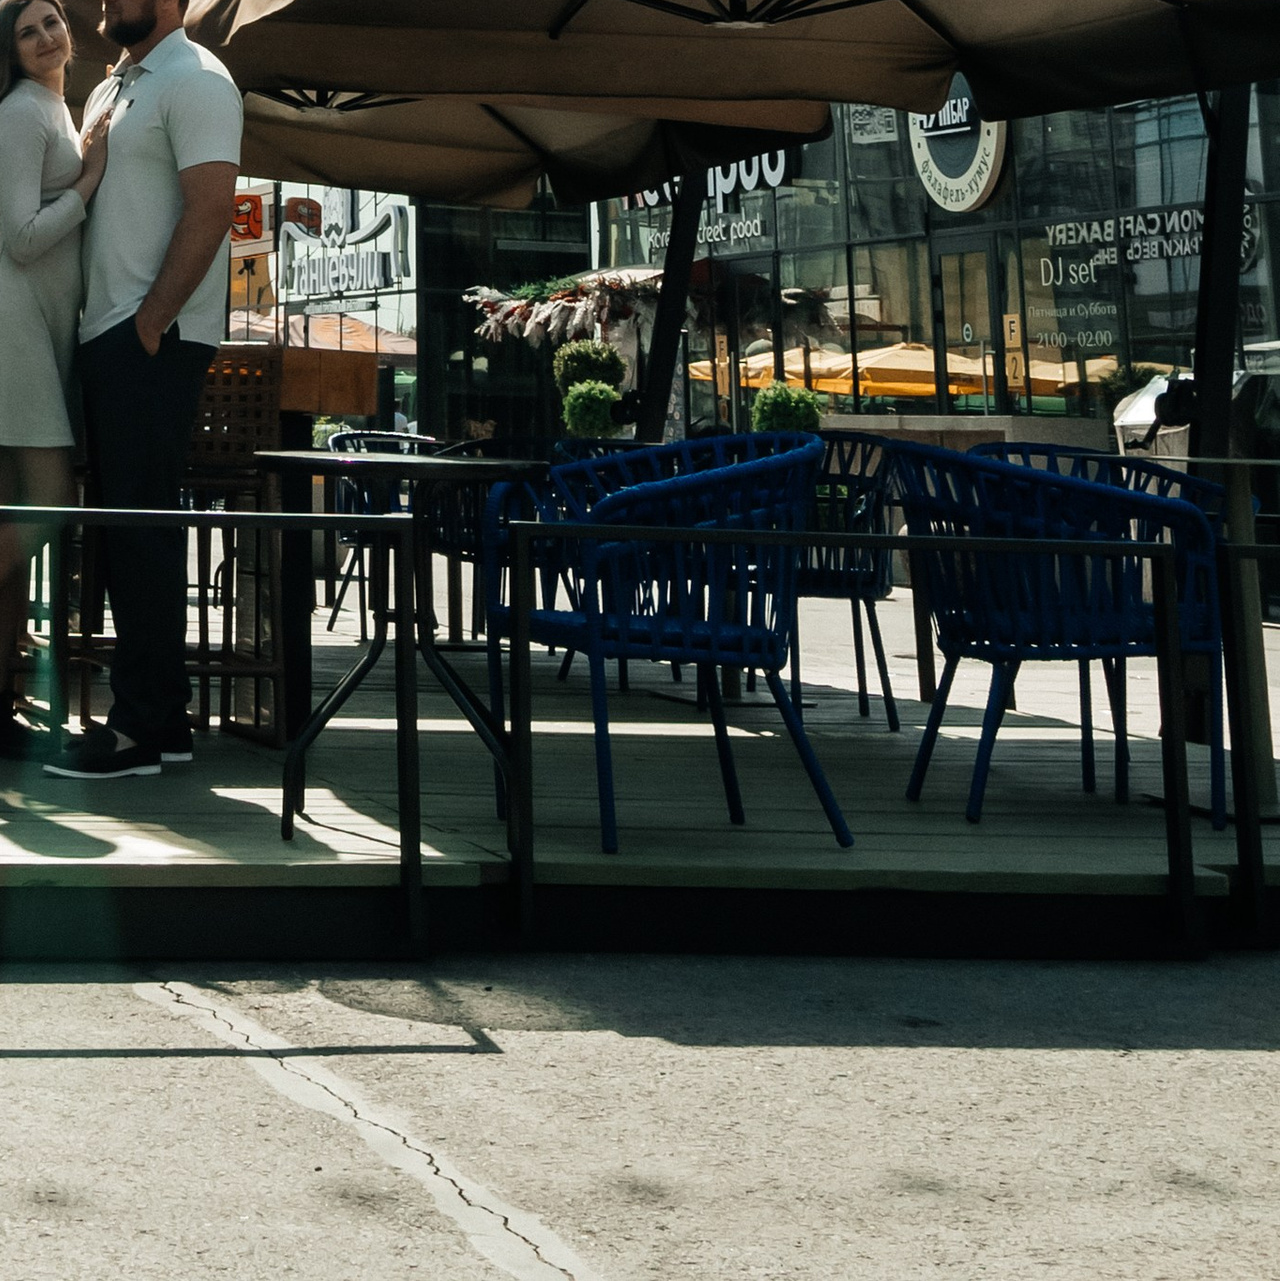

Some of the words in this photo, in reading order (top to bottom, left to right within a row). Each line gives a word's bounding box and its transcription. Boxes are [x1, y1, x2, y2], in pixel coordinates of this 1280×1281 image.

[696, 217, 727, 244] treet
[730, 212, 761, 246] food
[1040, 256, 1063, 287] DJ
[1068, 257, 1098, 285] set
[1028, 304, 1067, 319] Пятница
[1069, 307, 1076, 316] и
[1077, 302, 1117, 319] Суббота
[1008, 320, 1016, 342] F
[1077, 330, 1113, 348] 02.00
[1011, 356, 1019, 380] 2
